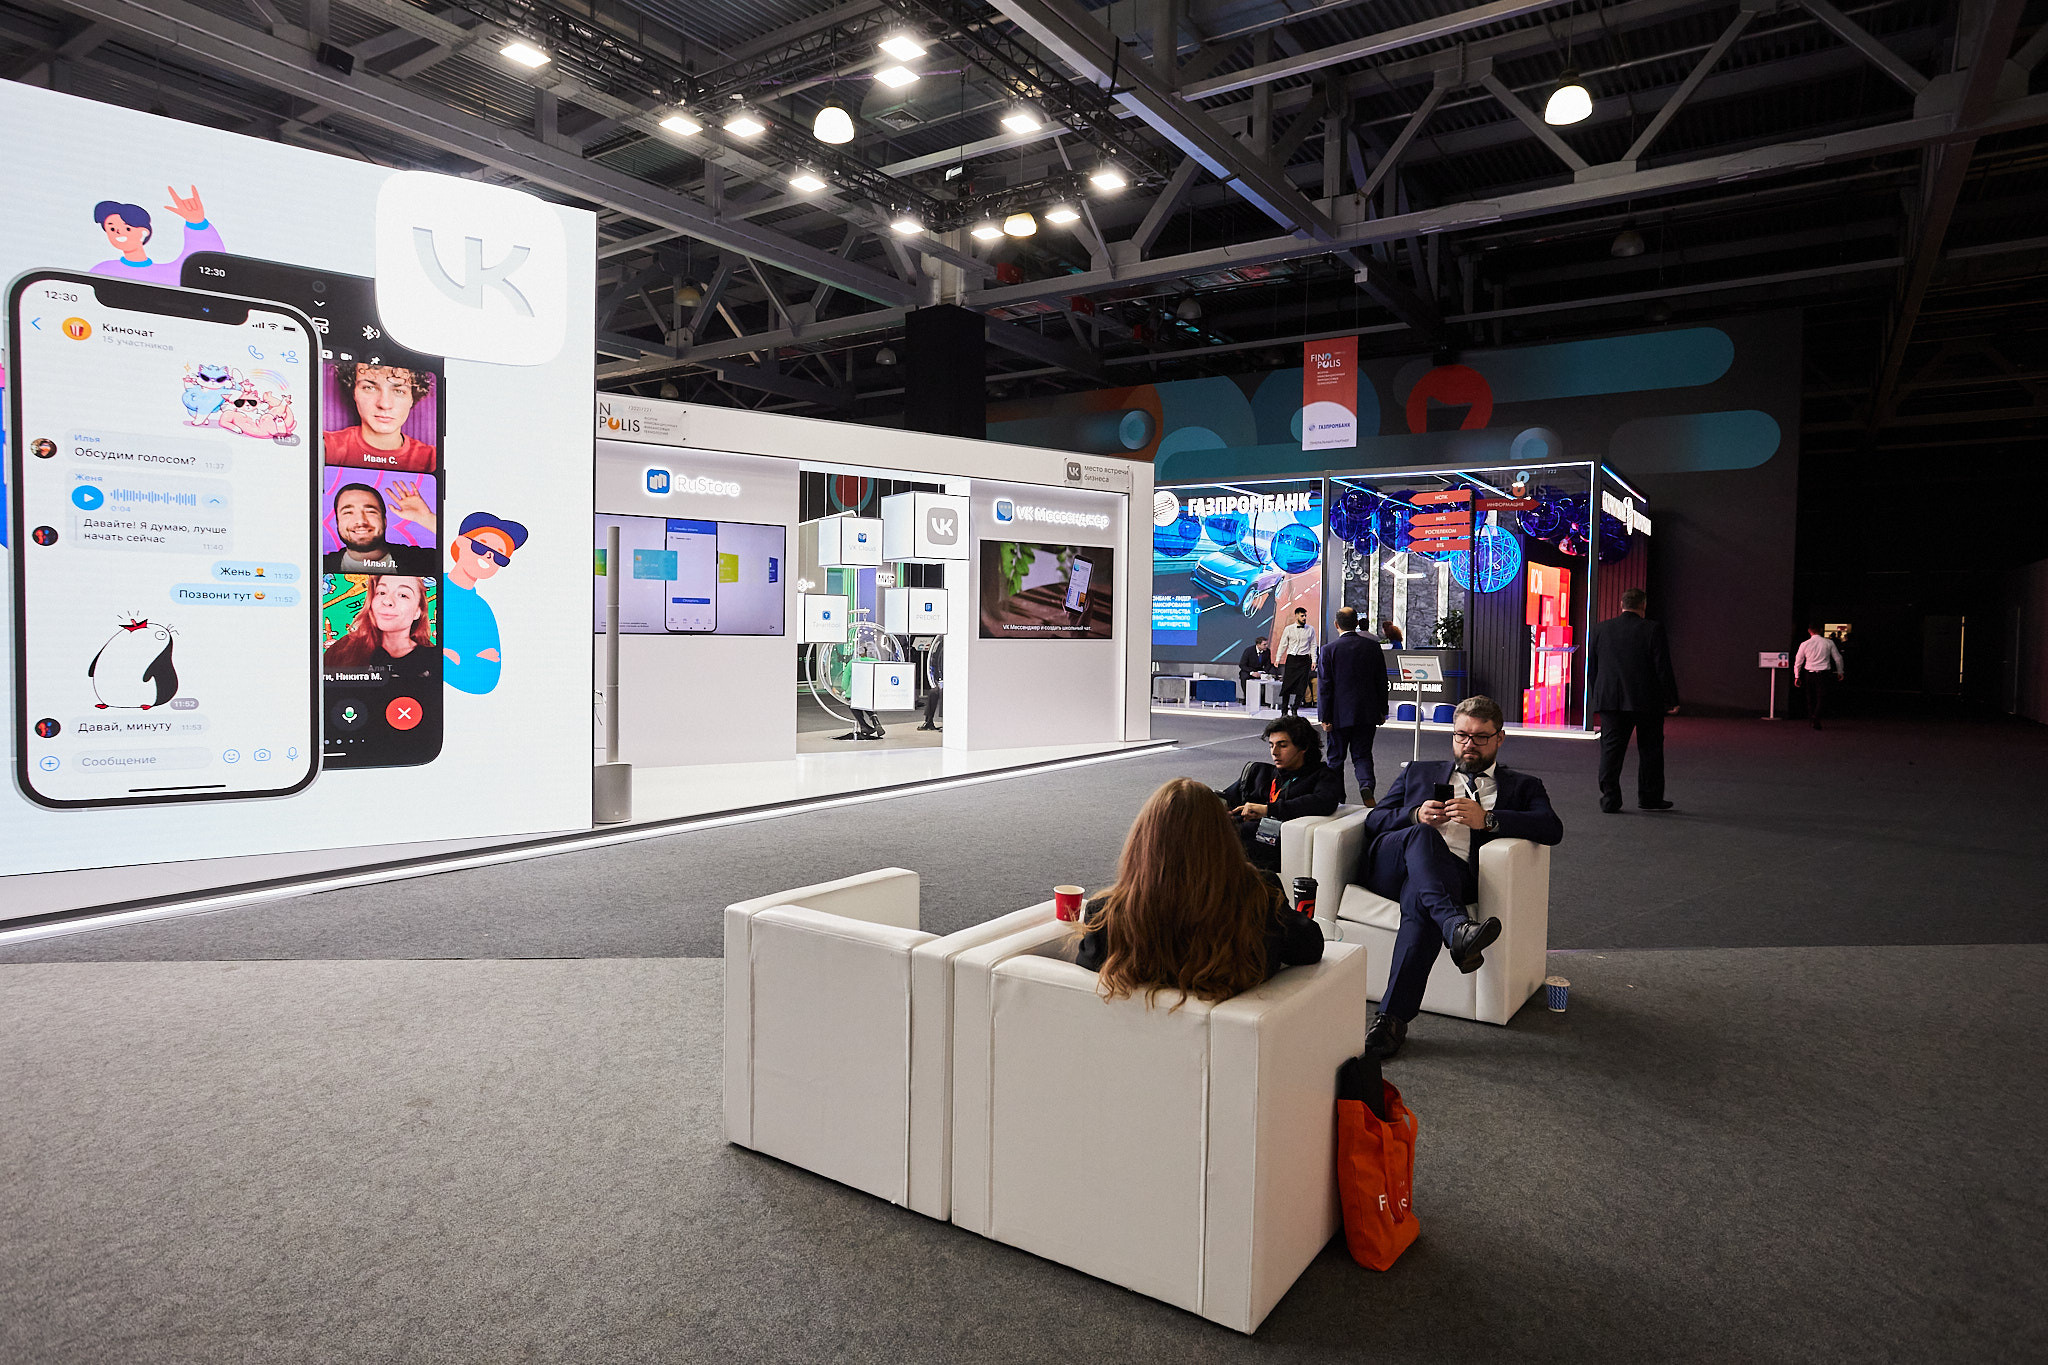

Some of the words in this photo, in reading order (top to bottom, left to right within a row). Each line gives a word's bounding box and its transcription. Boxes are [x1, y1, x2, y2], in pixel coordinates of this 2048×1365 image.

[198, 265, 226, 278] 12:30
[412, 226, 535, 318] VK
[44, 289, 78, 303] 12:30
[102, 322, 155, 338] Киночат
[102, 335, 114, 344] 15
[116, 337, 174, 352] участников
[1317, 359, 1341, 369] POLIS
[599, 415, 640, 433] POLIS
[1318, 422, 1351, 430] ГАЗПРОМБАНК
[74, 434, 101, 444] Илья
[74, 447, 134, 463] Обсудим
[137, 453, 196, 466] голосом?
[363, 453, 387, 464] Иван
[388, 456, 399, 465] С.
[204, 462, 225, 470] 11:37
[1084, 465, 1104, 473] место
[1104, 467, 1129, 476] встречи
[74, 472, 103, 483] Женя
[1083, 473, 1110, 483] бизнеса
[676, 475, 741, 496] RuStore
[110, 505, 131, 513] 0:04
[1187, 491, 1312, 517] ГАЗПРОМБАНК
[1016, 505, 1034, 521] VK
[1034, 506, 1110, 530] Мессенджер
[83, 518, 137, 530] Давайте!
[139, 521, 147, 529] Я
[150, 523, 191, 534] думаю,
[193, 525, 227, 536] лучше
[931, 517, 954, 537] VK
[1424, 528, 1457, 536] РОСТЕЛЕКОМ
[84, 532, 124, 543] начать
[126, 532, 166, 544] сейчас
[202, 543, 224, 551] 11:40
[363, 559, 387, 569] Илья
[388, 560, 398, 569] Л.
[220, 567, 251, 577] Жень
[274, 572, 294, 580] 11:52
[179, 589, 230, 600] Позвони
[232, 591, 251, 602] тут
[274, 595, 294, 604] 11:52
[1010, 624, 1041, 632] Мессенджер
[367, 663, 385, 672] Аля
[386, 664, 395, 672] Т.
[335, 672, 370, 682] Никита
[370, 672, 383, 681] М.
[174, 700, 196, 708] 11:52
[77, 722, 123, 734] Давай,
[126, 722, 172, 733] минуту
[181, 723, 202, 731] 11:53
[81, 754, 157, 768] Сообщение
